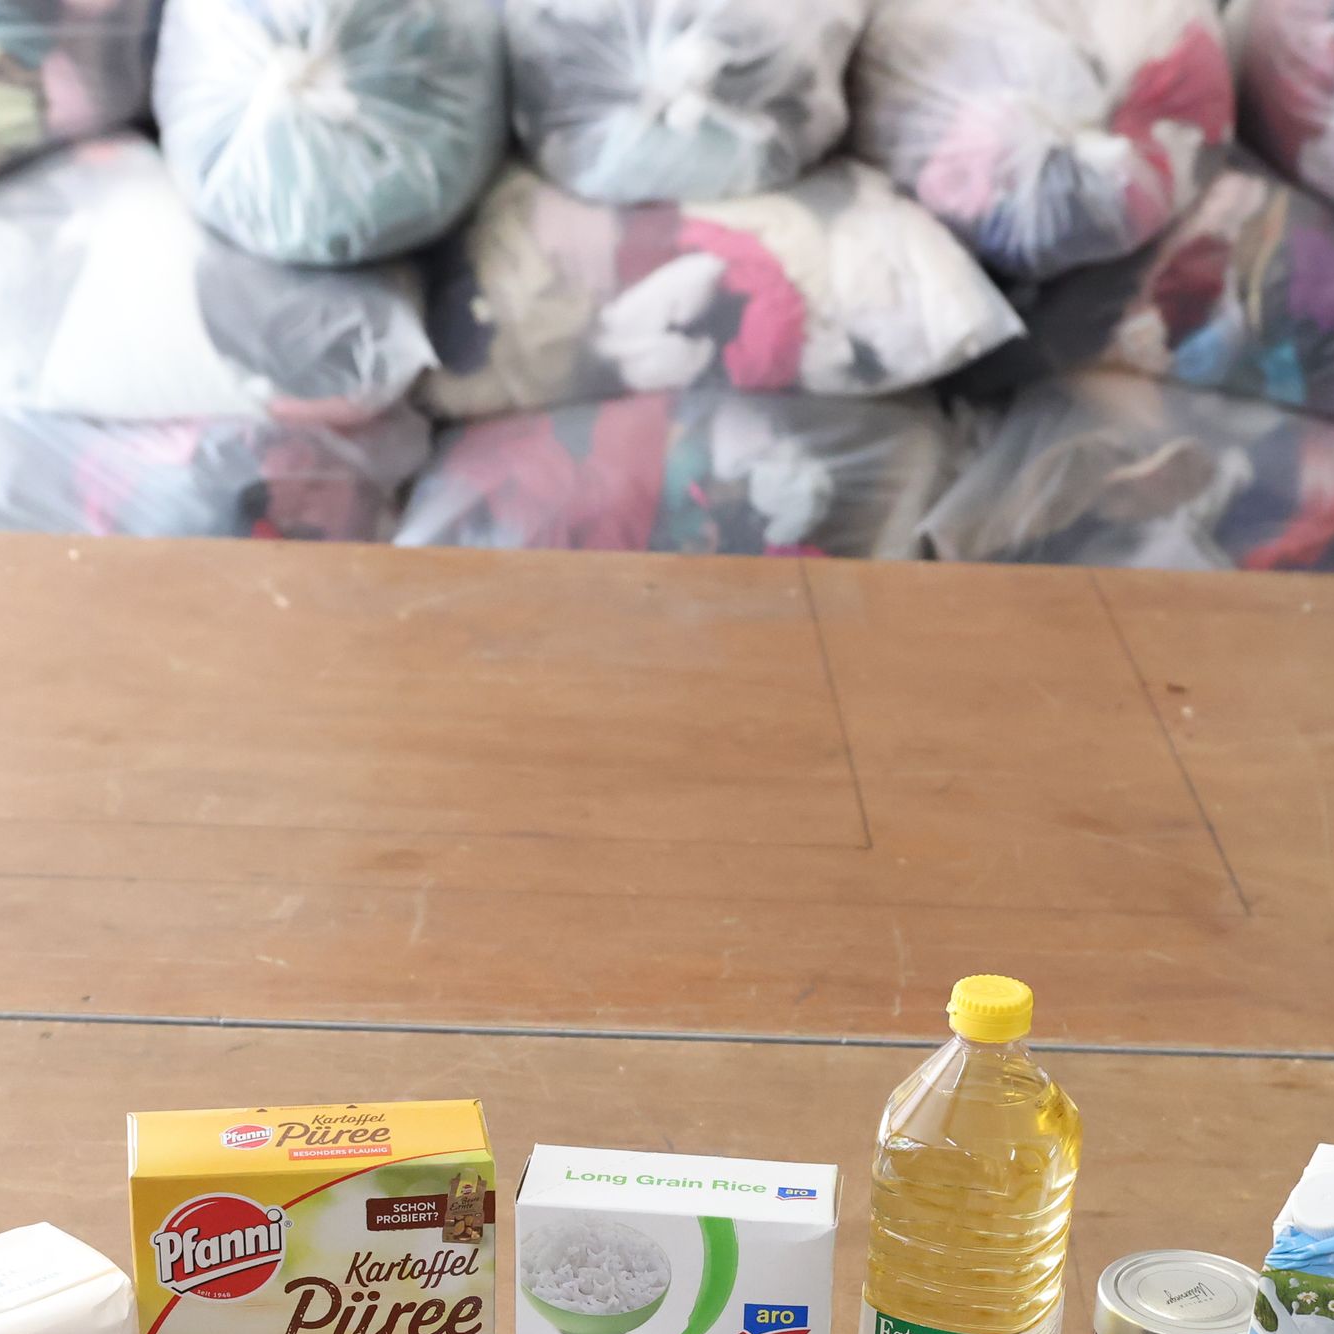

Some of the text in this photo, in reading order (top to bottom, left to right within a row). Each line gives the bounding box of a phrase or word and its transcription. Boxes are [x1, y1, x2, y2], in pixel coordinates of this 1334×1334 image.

[312, 1114, 385, 1127] Kartoffel
[222, 1128, 272, 1145] Pfanni
[276, 1122, 391, 1148] Püree
[293, 1147, 388, 1158] BESONDERS FLAUMIG
[565, 1167, 767, 1195] Long Grain Rice
[785, 1187, 809, 1197] aro
[393, 1202, 436, 1212] SCHON
[376, 1212, 439, 1224] PROBIERT?
[155, 1208, 283, 1283] Pfanni
[345, 1248, 480, 1289] Kartoffel
[756, 1305, 795, 1325] aro
